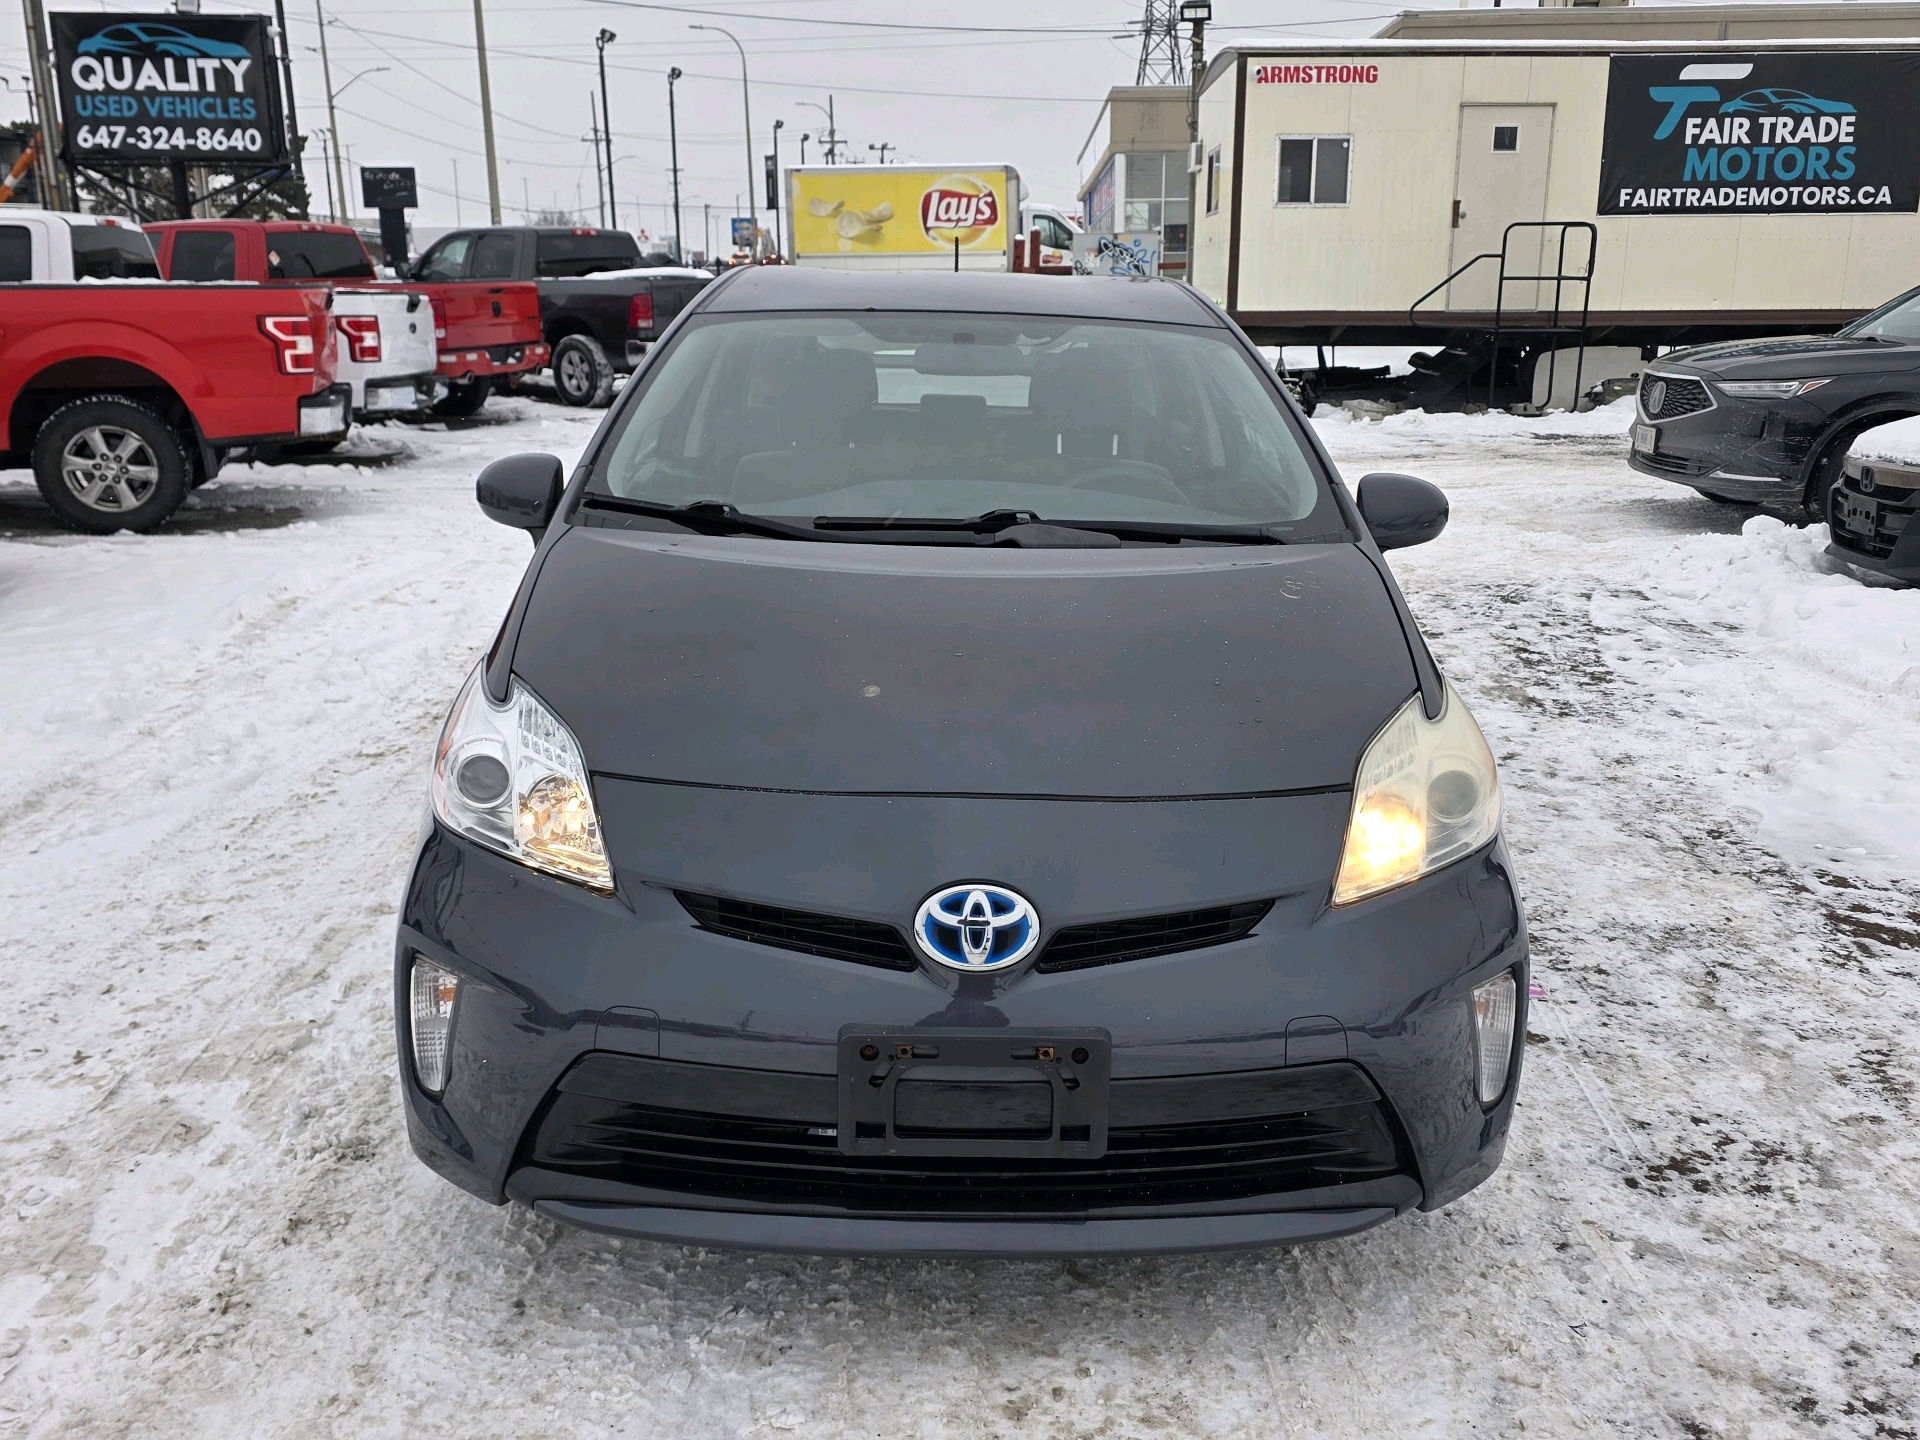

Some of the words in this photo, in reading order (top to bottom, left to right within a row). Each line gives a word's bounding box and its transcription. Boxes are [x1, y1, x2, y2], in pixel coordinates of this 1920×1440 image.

[71, 56, 252, 92] QUALITY
[1257, 65, 1378, 84] ARMSTRONG
[75, 95, 139, 118] USED
[142, 96, 257, 120] VEHICLES
[77, 124, 262, 151] 647-324-8640
[1685, 117, 1751, 144] FAIR
[1759, 116, 1856, 143] TRADE
[1683, 146, 1857, 182] MOTORS
[1619, 185, 1892, 207] FAIRTRADEMOTORS.CA
[926, 191, 993, 229] Lay's
